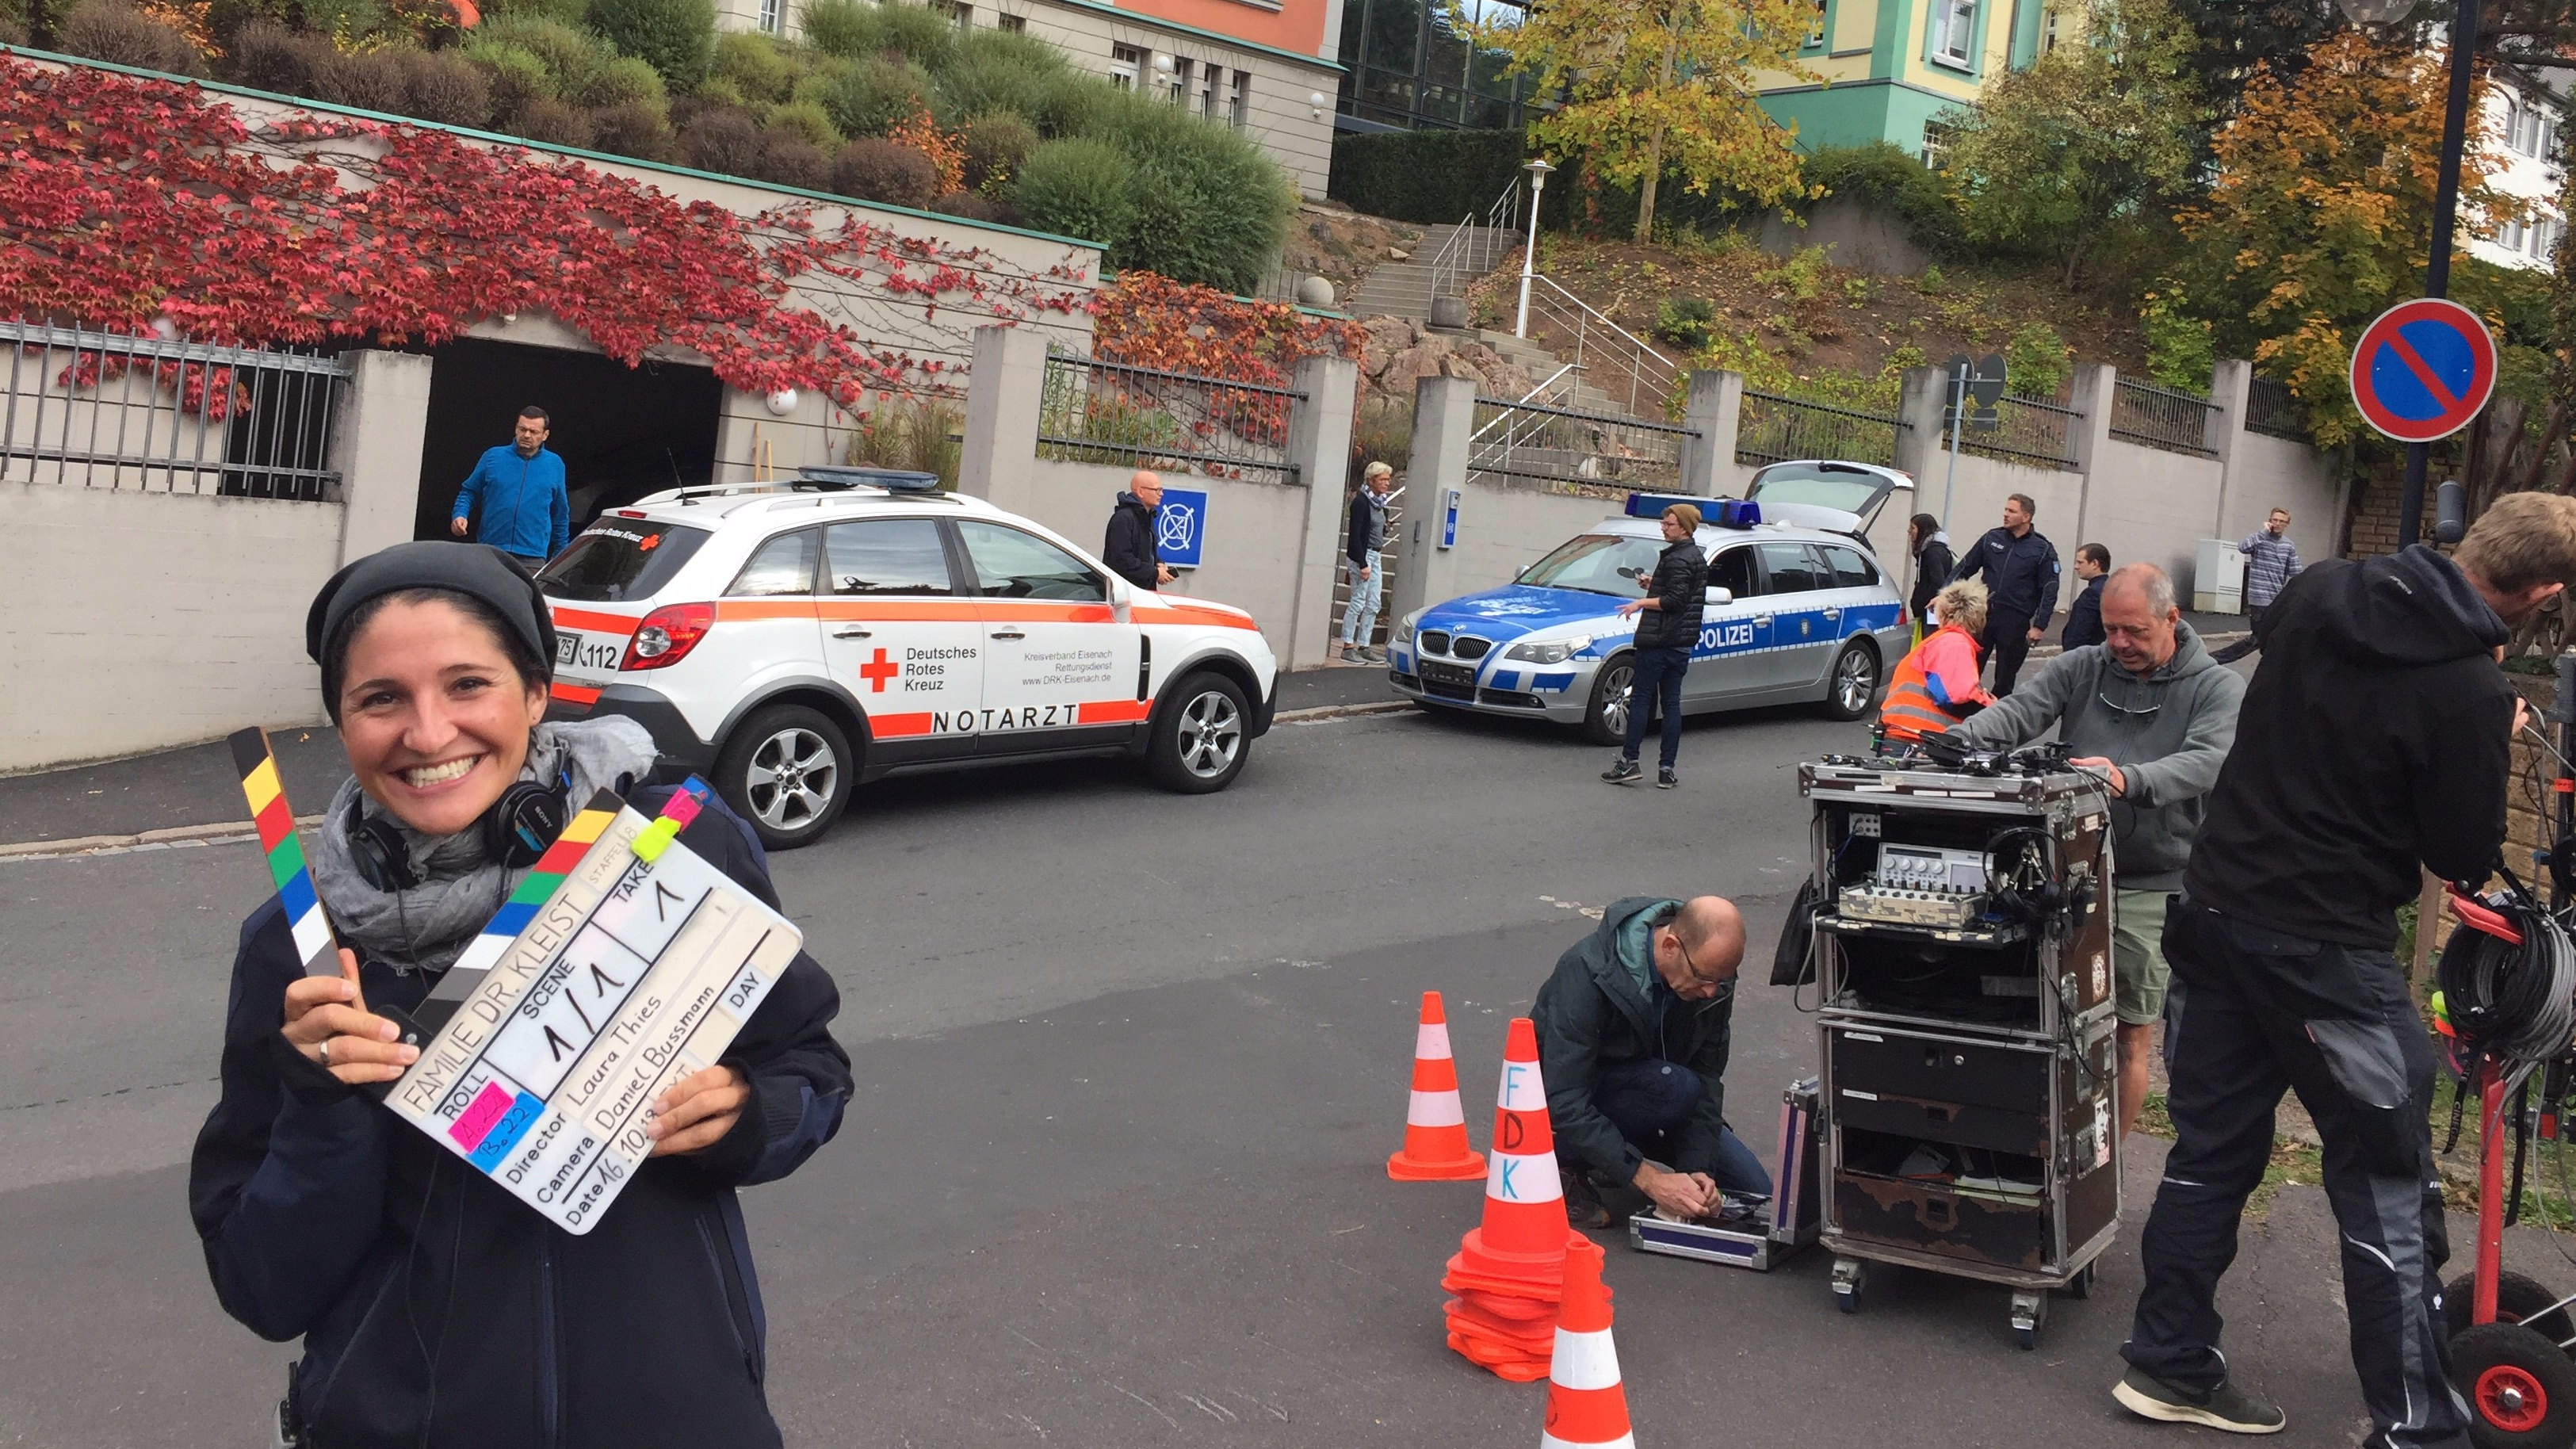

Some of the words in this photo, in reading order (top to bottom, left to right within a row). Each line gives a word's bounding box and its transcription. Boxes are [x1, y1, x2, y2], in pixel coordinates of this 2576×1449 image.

[587, 644, 617, 670] 112
[907, 647, 977, 661] Deutsches
[1024, 651, 1076, 661] Kreisverband
[1078, 650, 1113, 660] Eisenach
[1695, 624, 1753, 650] POLIZEI
[904, 679, 944, 692] Kreuz
[906, 663, 945, 676] Rotes
[1055, 662, 1113, 673] Rettungsdienst
[933, 704, 1076, 733] NOTARZT
[534, 805, 553, 829] SONY
[589, 841, 629, 885] STAFFEL
[613, 862, 655, 904] TAKE
[655, 880, 684, 922] 1
[403, 1022, 483, 1112] FAMILIE
[471, 981, 521, 1025] DR.
[506, 893, 585, 980] KLEIST
[523, 958, 576, 1019] SCENE
[728, 971, 760, 1009] DAY
[566, 1050, 620, 1107] Laura
[610, 996, 662, 1046] Thies
[594, 1066, 652, 1132] Daniel
[642, 985, 715, 1069] Bussmann
[441, 1073, 489, 1121] ROLL
[506, 1112, 567, 1185] Director
[537, 1135, 595, 1204] Camera
[565, 1182, 604, 1226] Date
